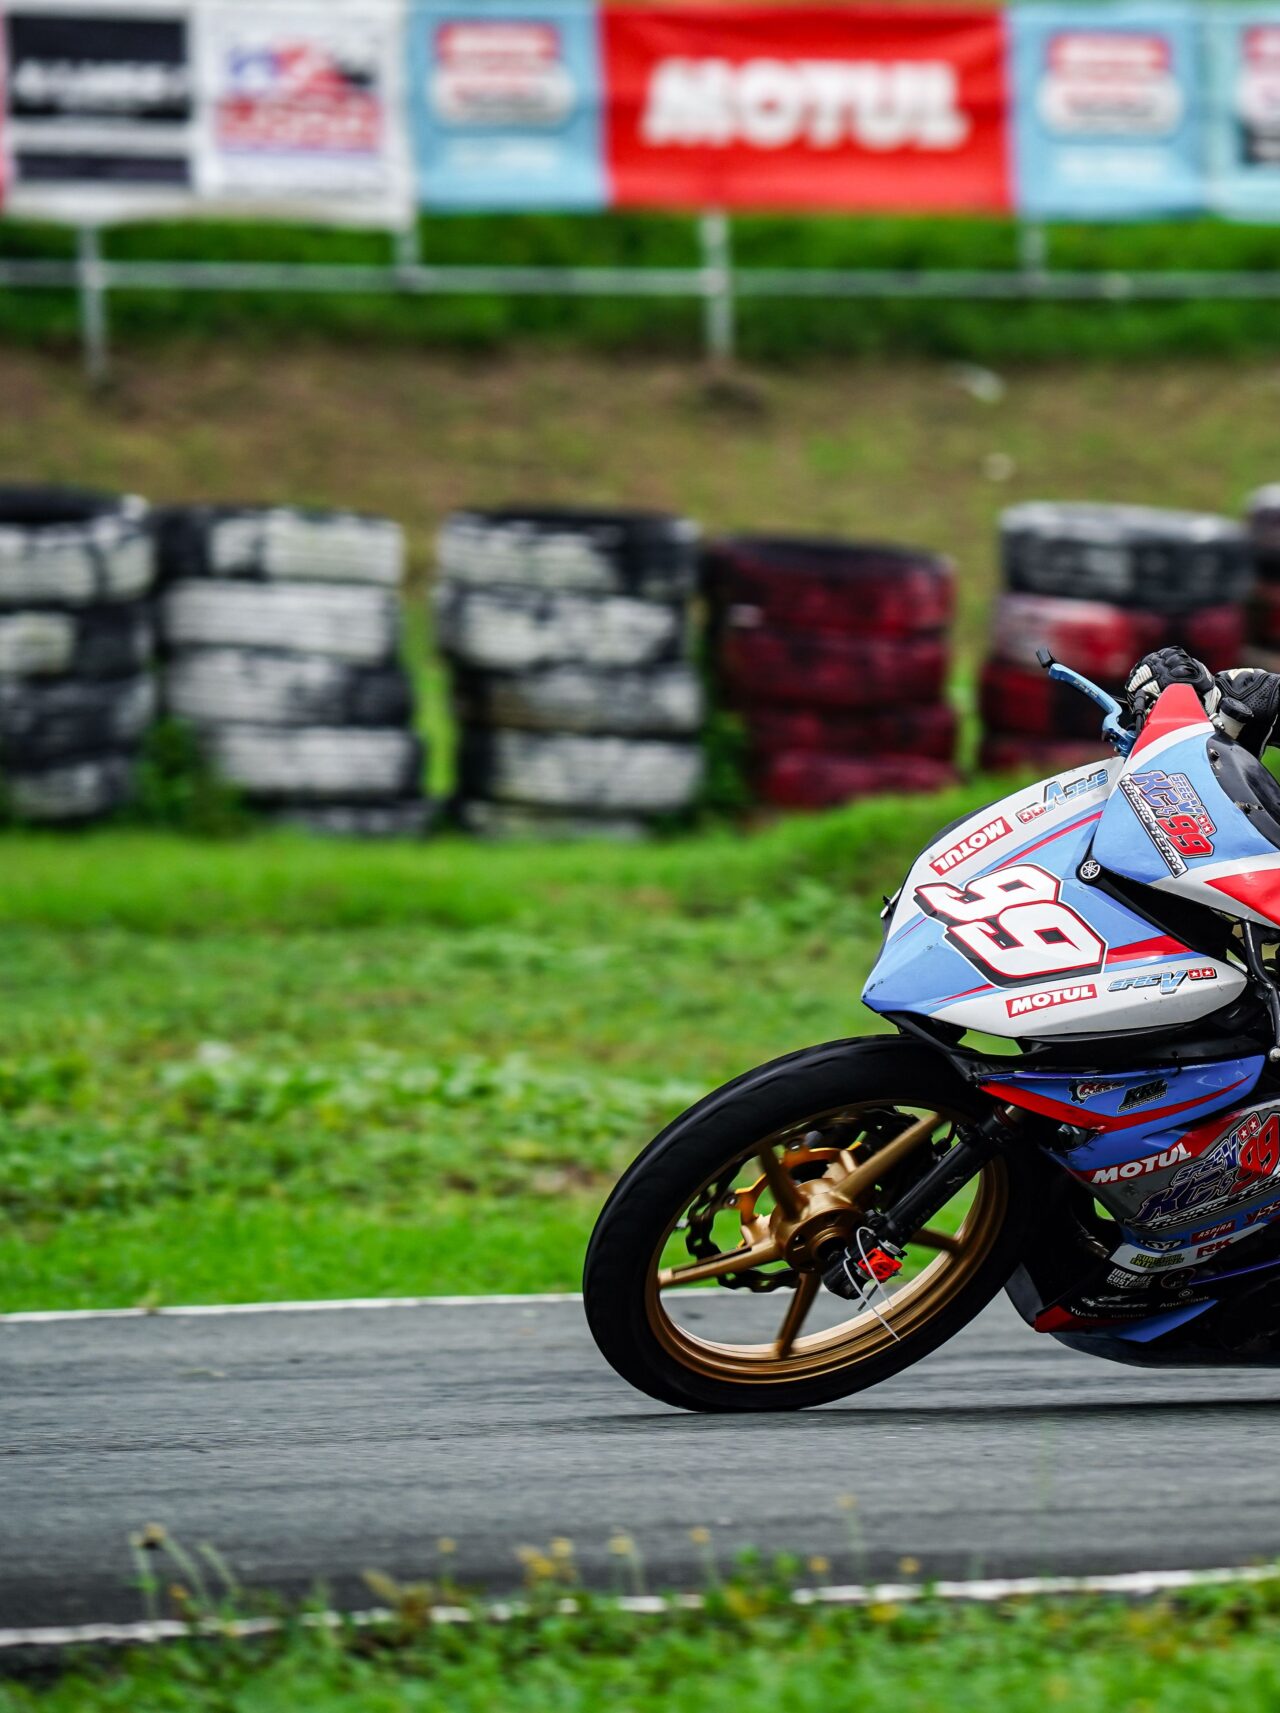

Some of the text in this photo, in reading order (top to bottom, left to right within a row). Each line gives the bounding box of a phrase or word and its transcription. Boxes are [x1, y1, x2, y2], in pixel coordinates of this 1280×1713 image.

[640, 58, 969, 149] MOTUL
[934, 820, 1008, 872] MOTUL
[1120, 780, 1183, 870] RACING TEAM
[1155, 814, 1214, 857] 99
[913, 864, 1106, 986] 99
[1011, 986, 1094, 1015] MOTUL
[1091, 1142, 1193, 1185] MOTUL
